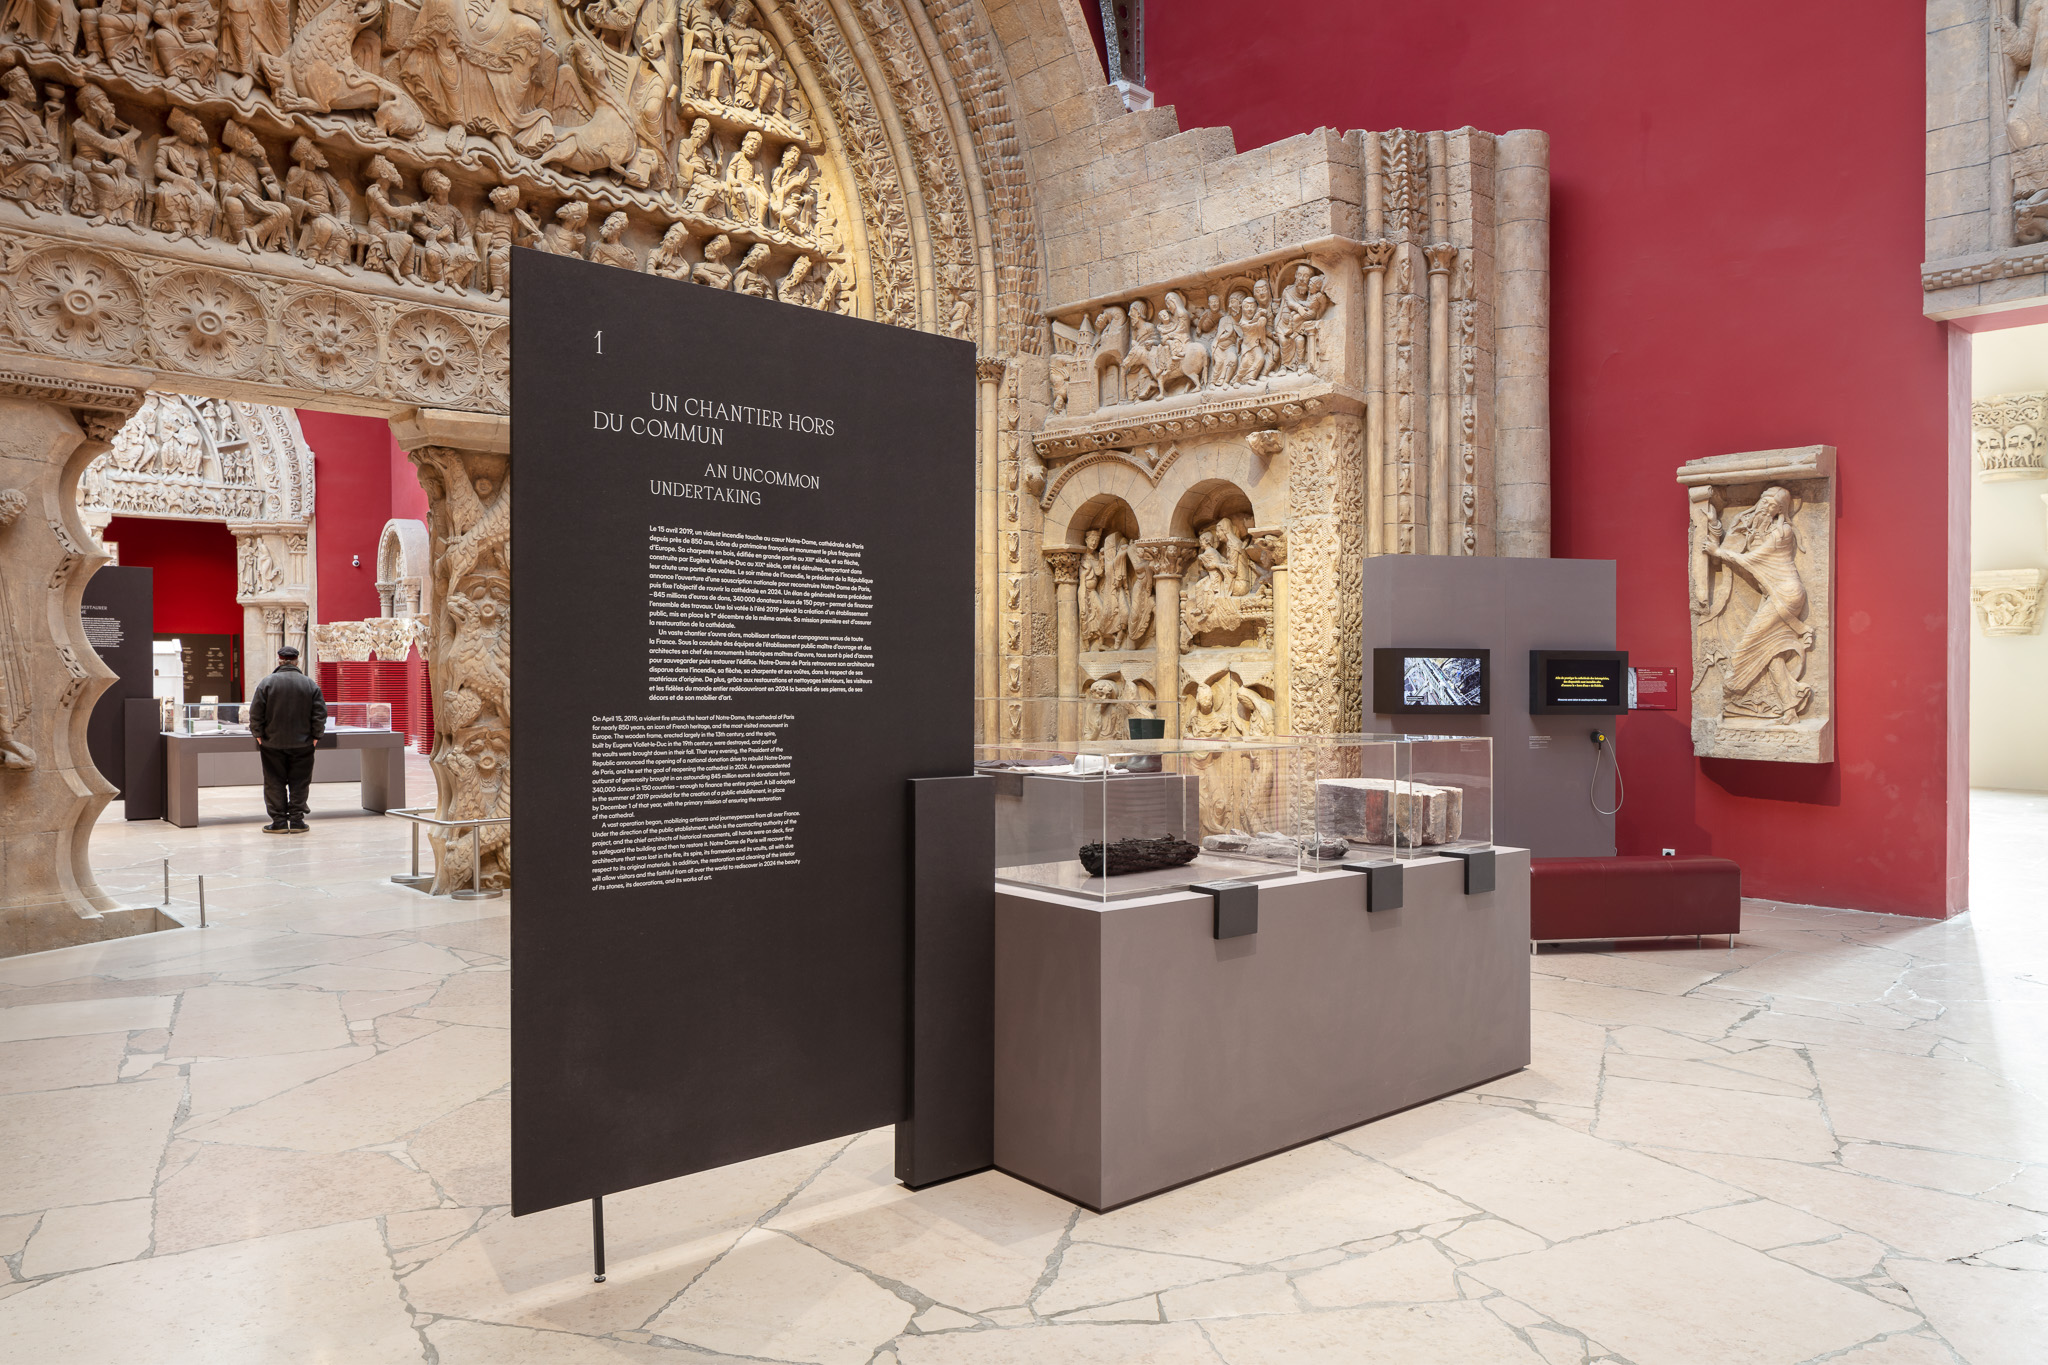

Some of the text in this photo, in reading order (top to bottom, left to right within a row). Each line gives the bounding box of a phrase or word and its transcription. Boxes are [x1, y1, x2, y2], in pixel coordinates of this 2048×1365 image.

[594, 330, 603, 355] 1
[650, 392, 835, 437] UN CHANTIER HORS
[593, 410, 724, 446] DU COMMUN
[704, 463, 820, 490] AN UNCOMMON
[650, 480, 761, 505] UNDERTAKING
[649, 534, 669, 543] depuis
[679, 527, 694, 536] 2019,
[722, 531, 745, 540] incendie
[721, 577, 753, 585] souscription
[753, 579, 778, 587] nationale
[689, 723, 712, 731] heritage,
[621, 777, 649, 785] generosity
[632, 880, 665, 888] decorations,
